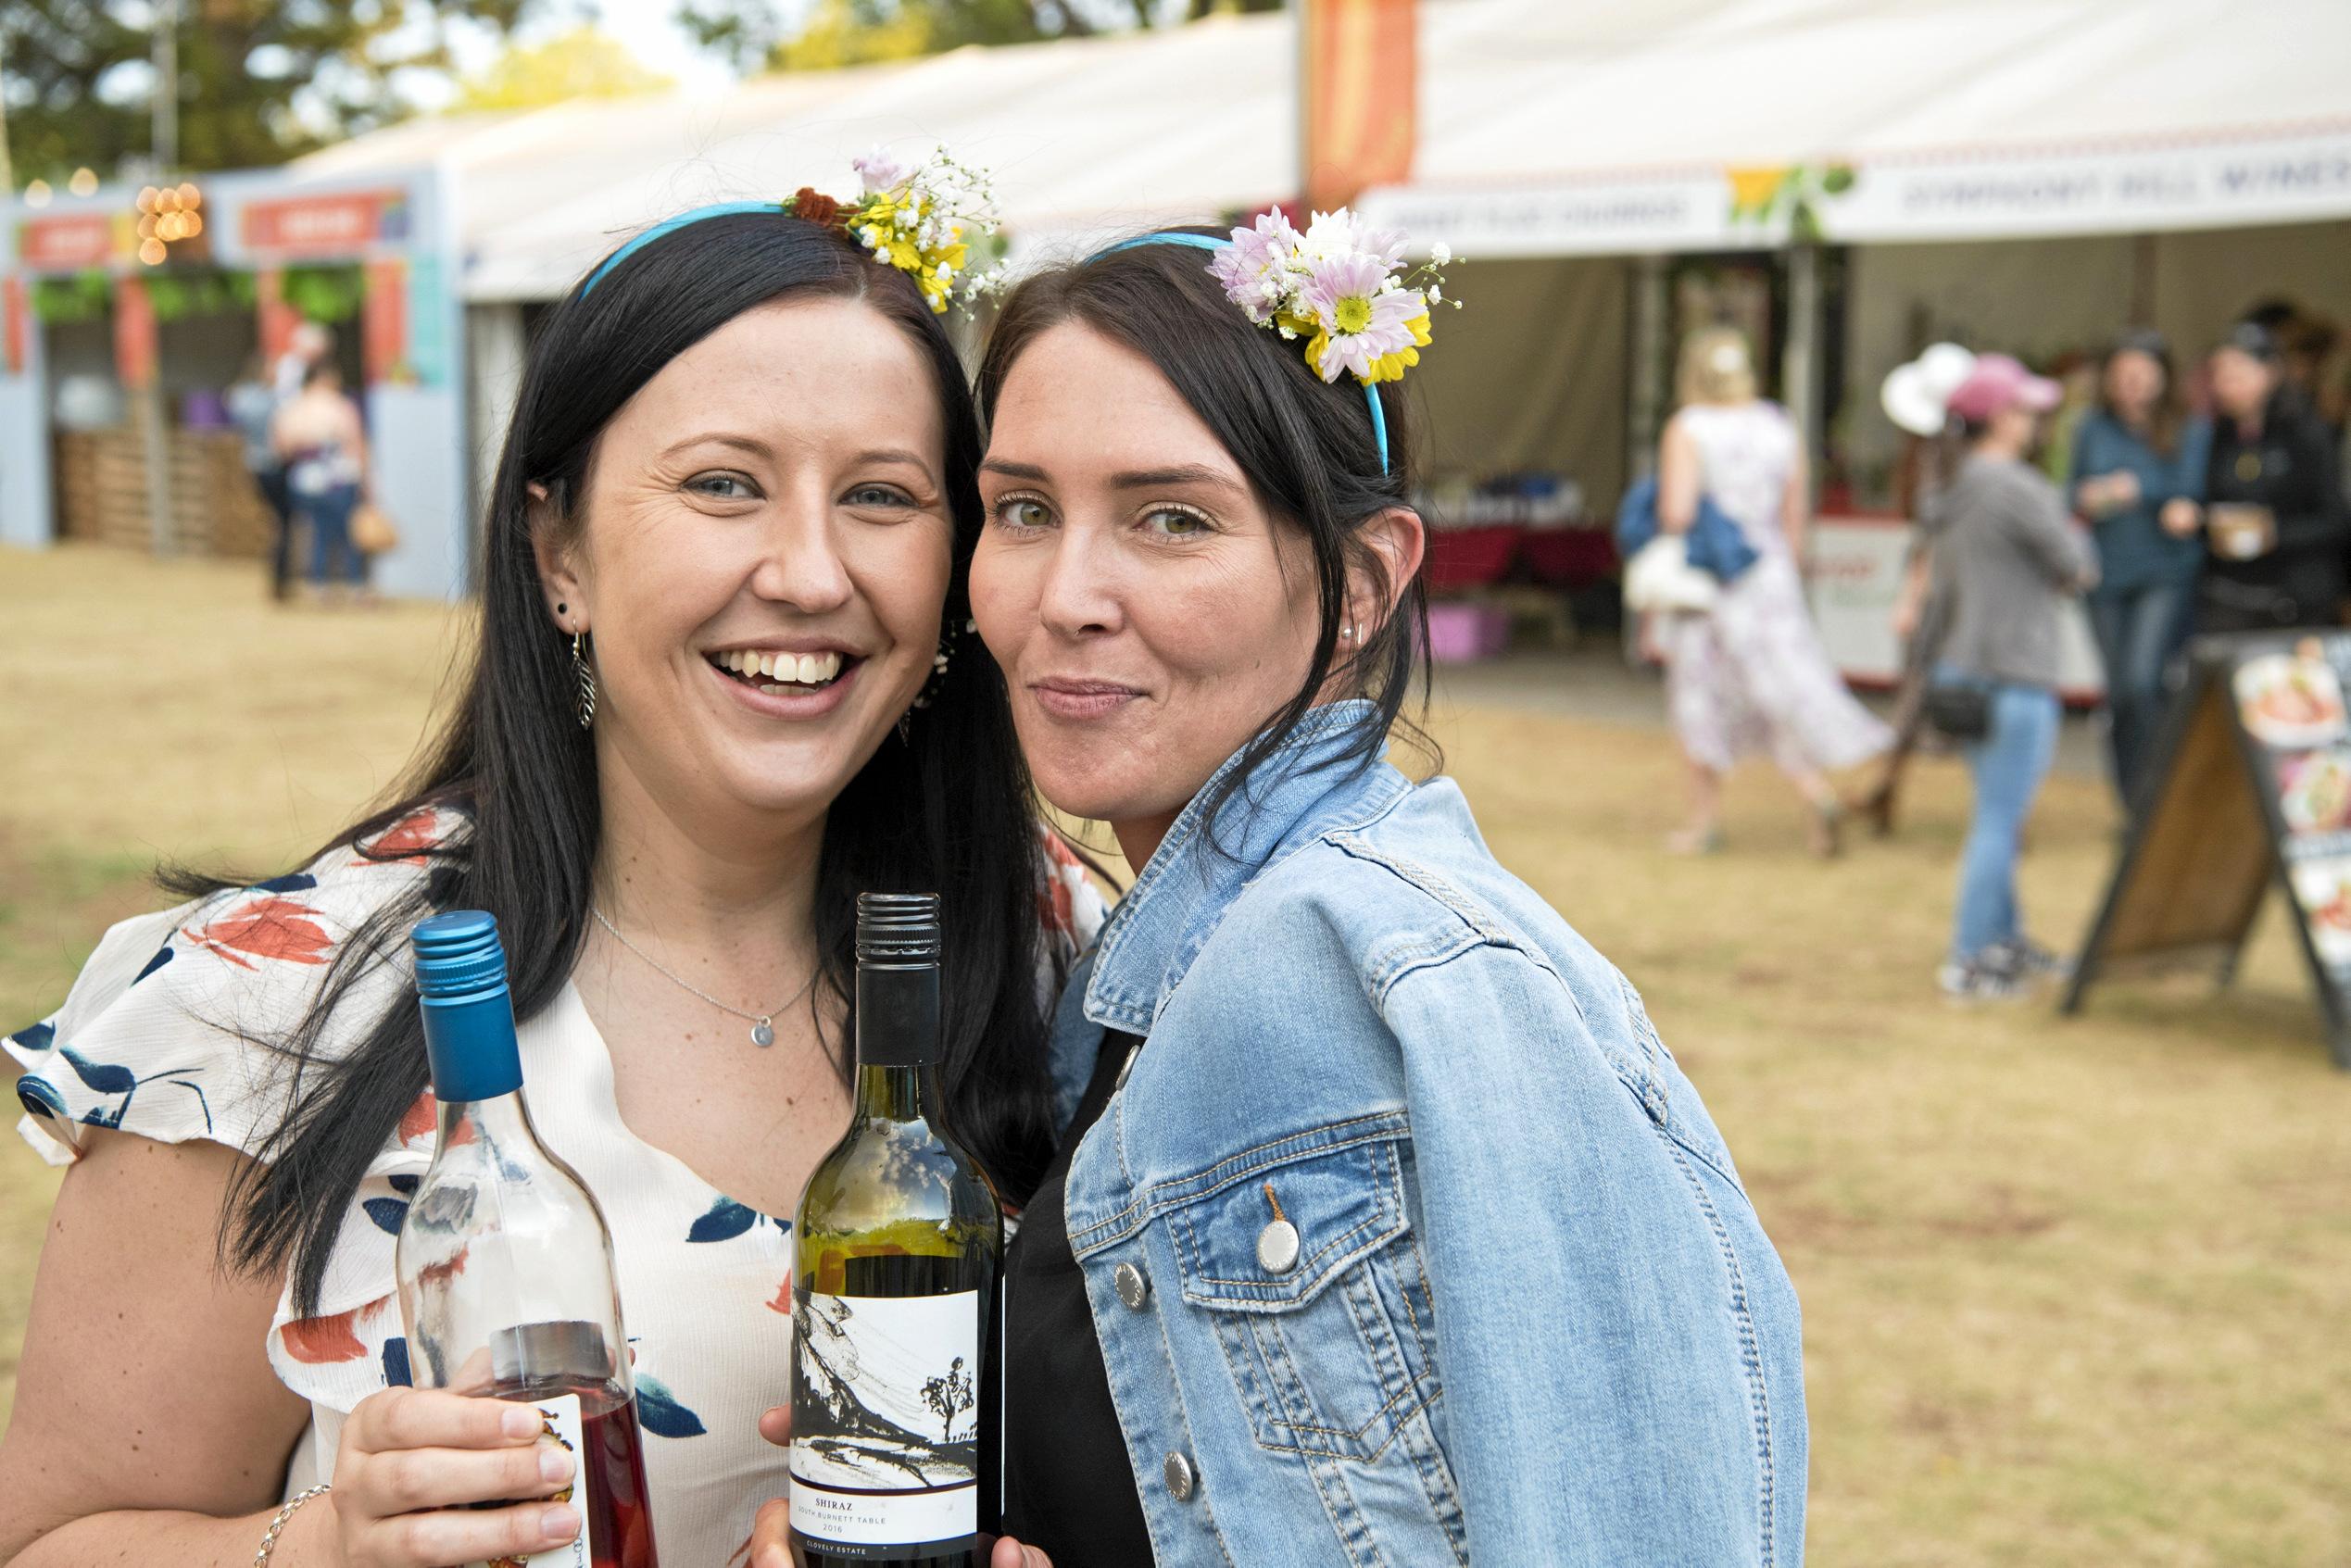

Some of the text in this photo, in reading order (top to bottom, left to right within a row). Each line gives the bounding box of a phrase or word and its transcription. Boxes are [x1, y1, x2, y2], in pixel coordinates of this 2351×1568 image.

[815, 1498, 852, 1512] SHIRAZ
[798, 1506, 815, 1516] SOUTH
[817, 1512, 852, 1523] BURNETT
[823, 1524, 843, 1534] 2016
[806, 1540, 866, 1555] CLOVELY ESTATE
